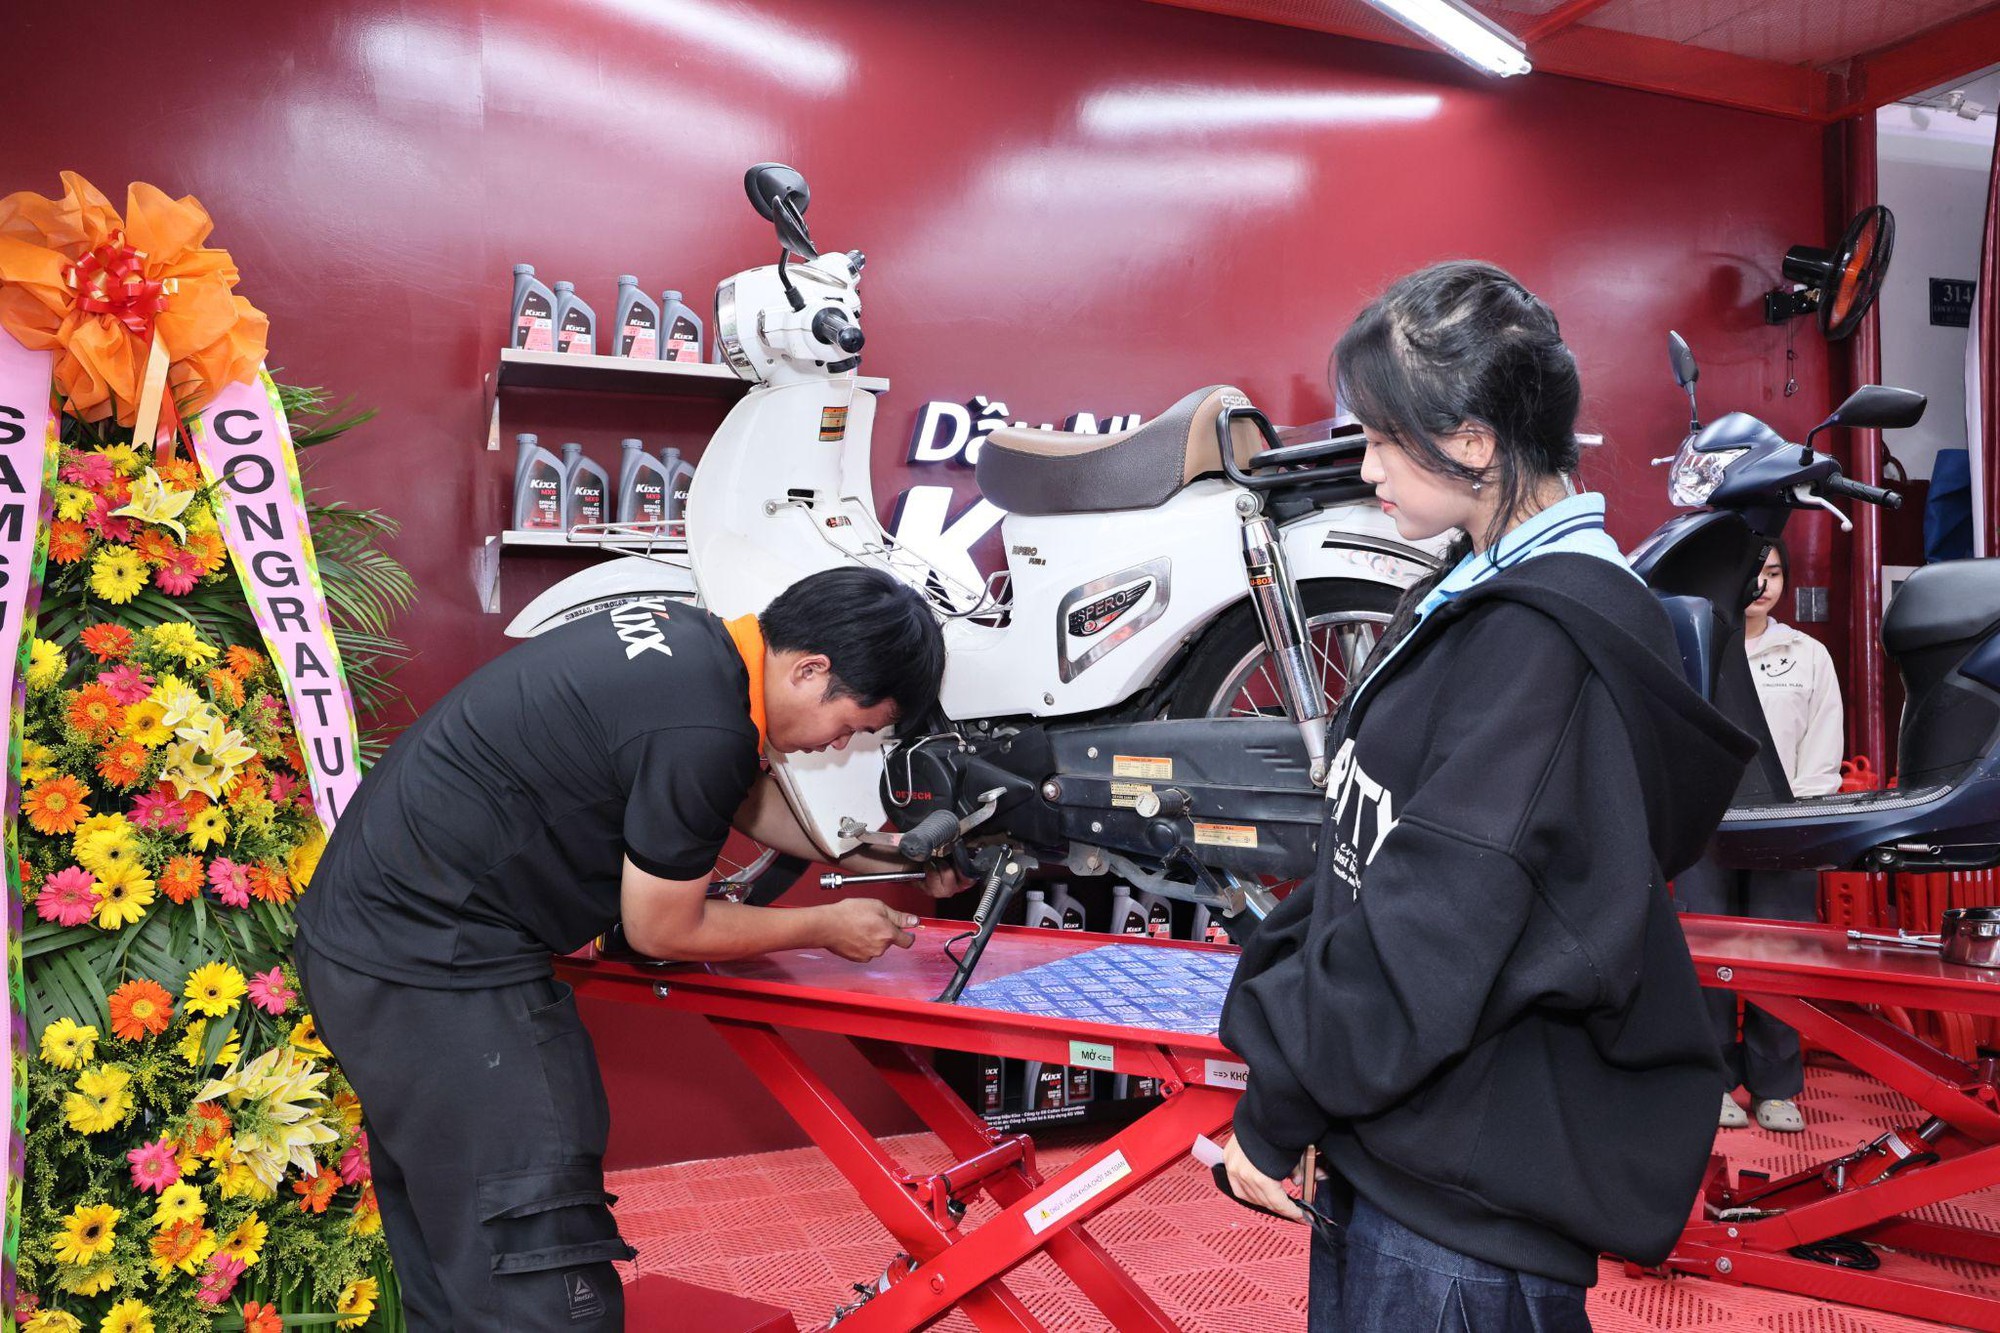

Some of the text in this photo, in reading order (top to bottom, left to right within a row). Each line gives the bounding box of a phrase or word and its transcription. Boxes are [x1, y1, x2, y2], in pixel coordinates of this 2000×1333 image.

[1943, 284, 1971, 304] 314
[525, 309, 546, 317] Kixx
[630, 319, 651, 327] Kixx
[565, 324, 586, 332] Kixx
[530, 479, 557, 489] Kixx
[636, 484, 661, 493] Kixx
[574, 486, 600, 496] Kixx
[1040, 1072, 1062, 1082] Kixx
